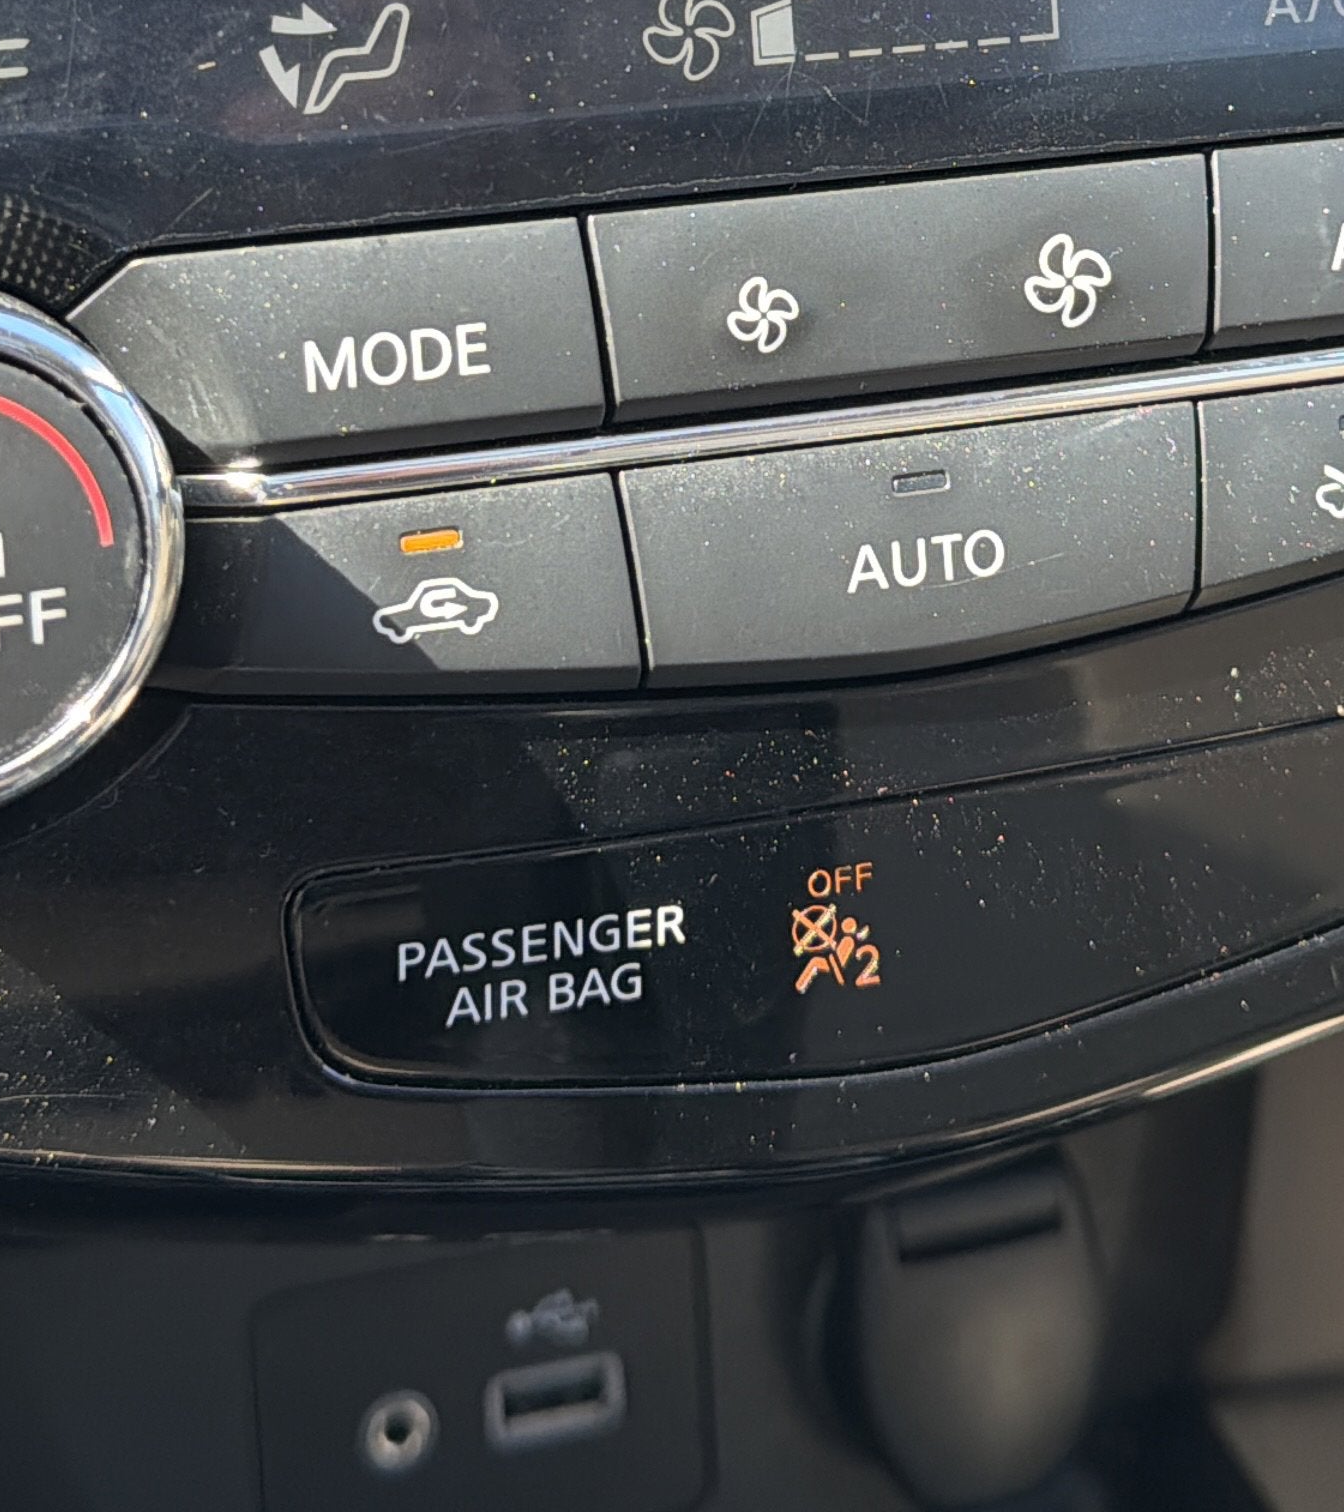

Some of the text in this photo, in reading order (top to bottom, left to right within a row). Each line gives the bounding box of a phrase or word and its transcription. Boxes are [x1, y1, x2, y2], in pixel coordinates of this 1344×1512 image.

[304, 322, 492, 393] MODE
[847, 529, 1007, 595] AUTO
[807, 861, 873, 898] OFF
[397, 904, 687, 982] PASSENGER
[855, 944, 881, 987] 2
[445, 963, 644, 1029] AIR BAG
